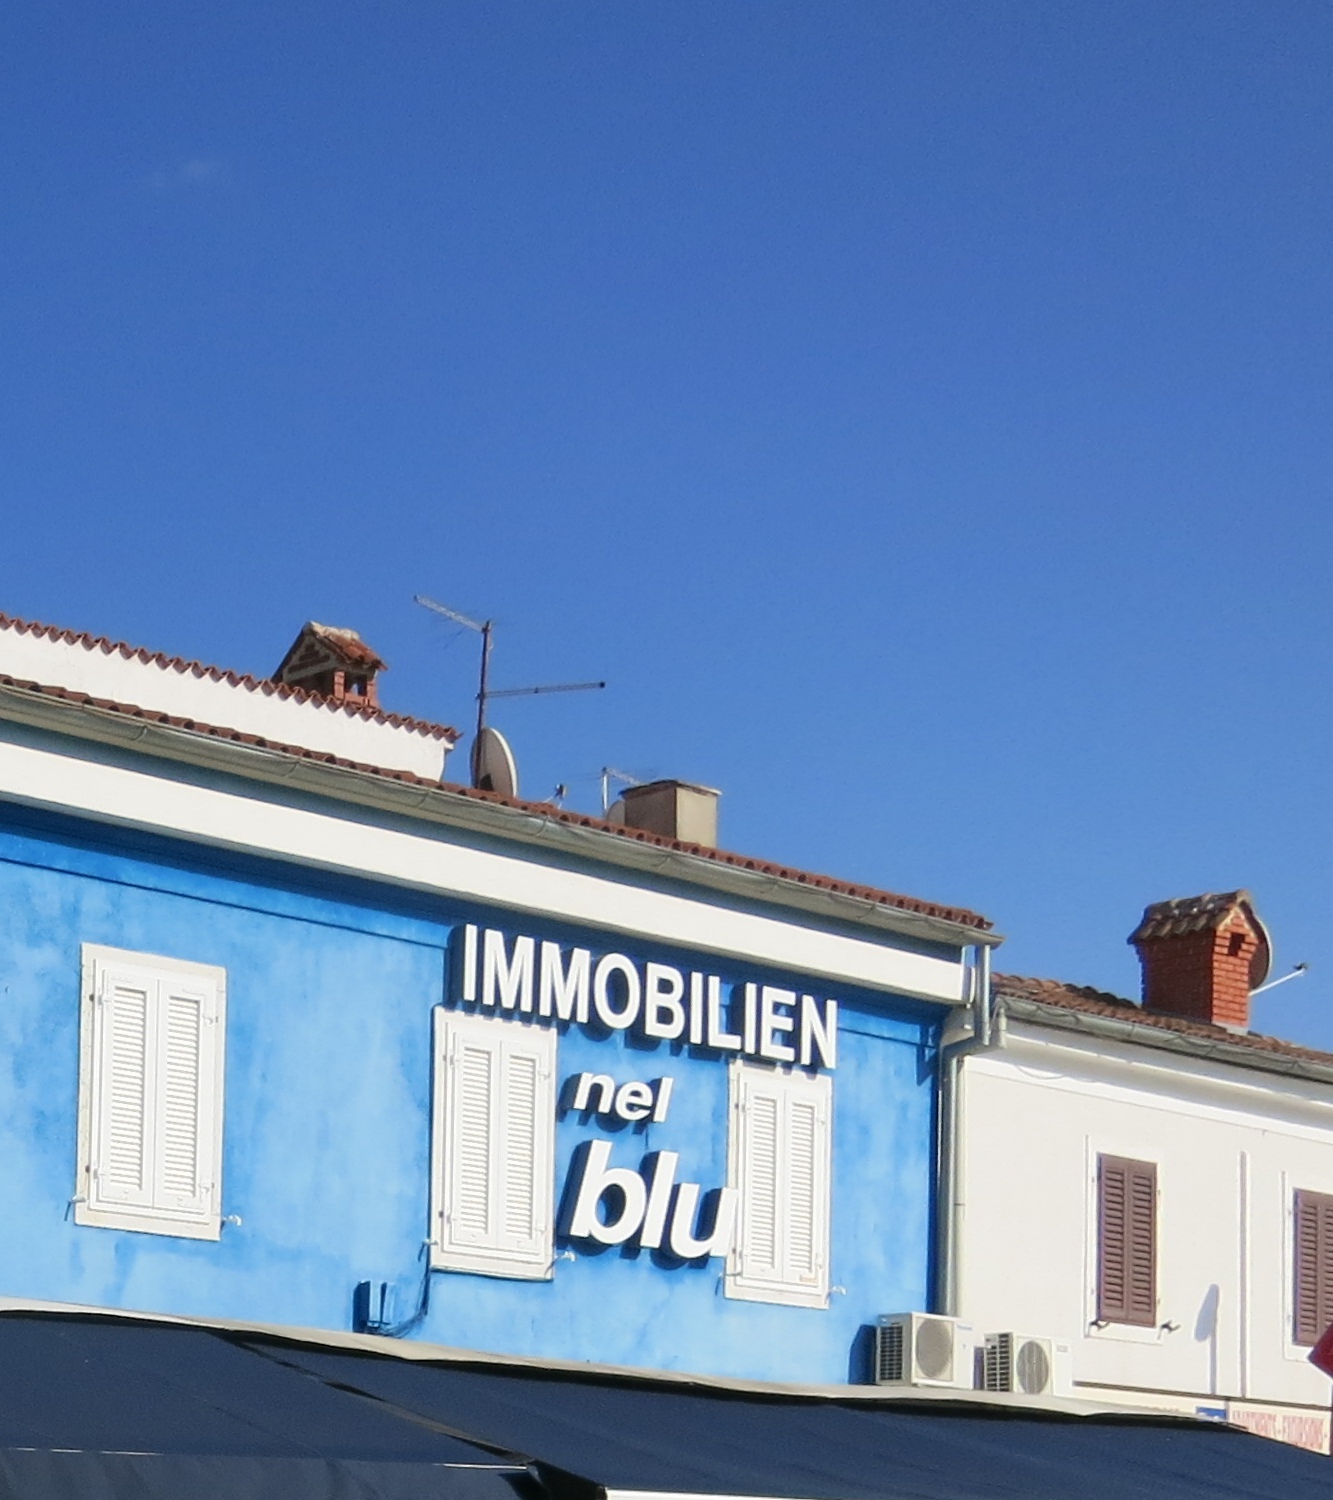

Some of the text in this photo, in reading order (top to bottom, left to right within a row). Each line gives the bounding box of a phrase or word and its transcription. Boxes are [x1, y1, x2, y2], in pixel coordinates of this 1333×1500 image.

[463, 924, 837, 1069] IMMOBILIEN
[574, 1072, 673, 1123] nel
[570, 1139, 737, 1258] blu
